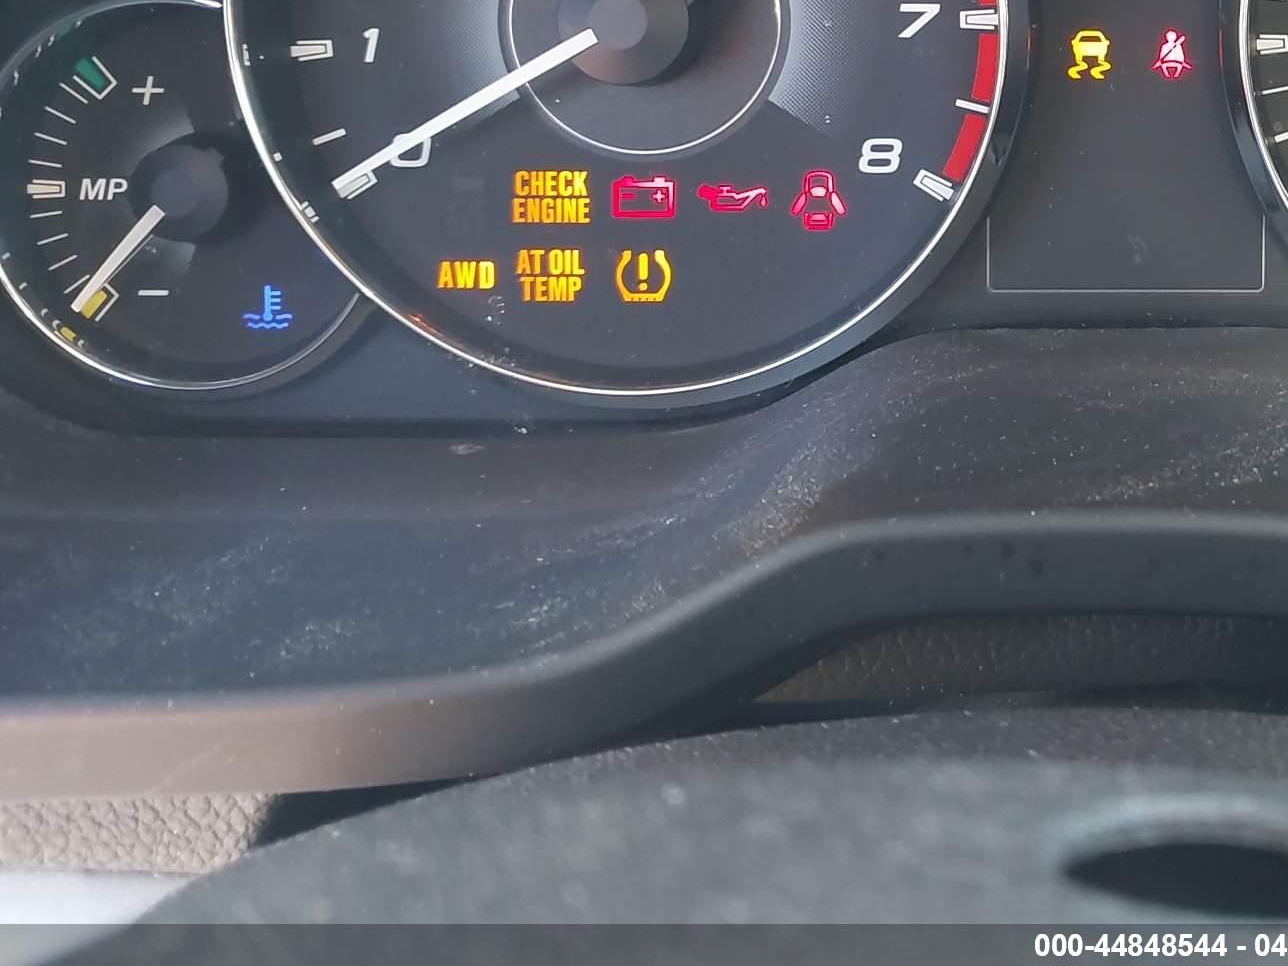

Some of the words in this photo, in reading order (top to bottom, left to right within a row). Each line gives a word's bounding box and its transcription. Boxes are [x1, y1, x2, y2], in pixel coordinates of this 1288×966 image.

[897, 1, 942, 40] 7
[362, 27, 381, 64] 1
[858, 137, 903, 174] 8
[79, 178, 128, 202] MP
[512, 169, 590, 197] CHECK
[511, 196, 592, 224] ENGINE
[436, 260, 496, 289] AWD
[516, 248, 546, 275] AT
[548, 248, 585, 275] OIL
[519, 275, 583, 303] TEMP
